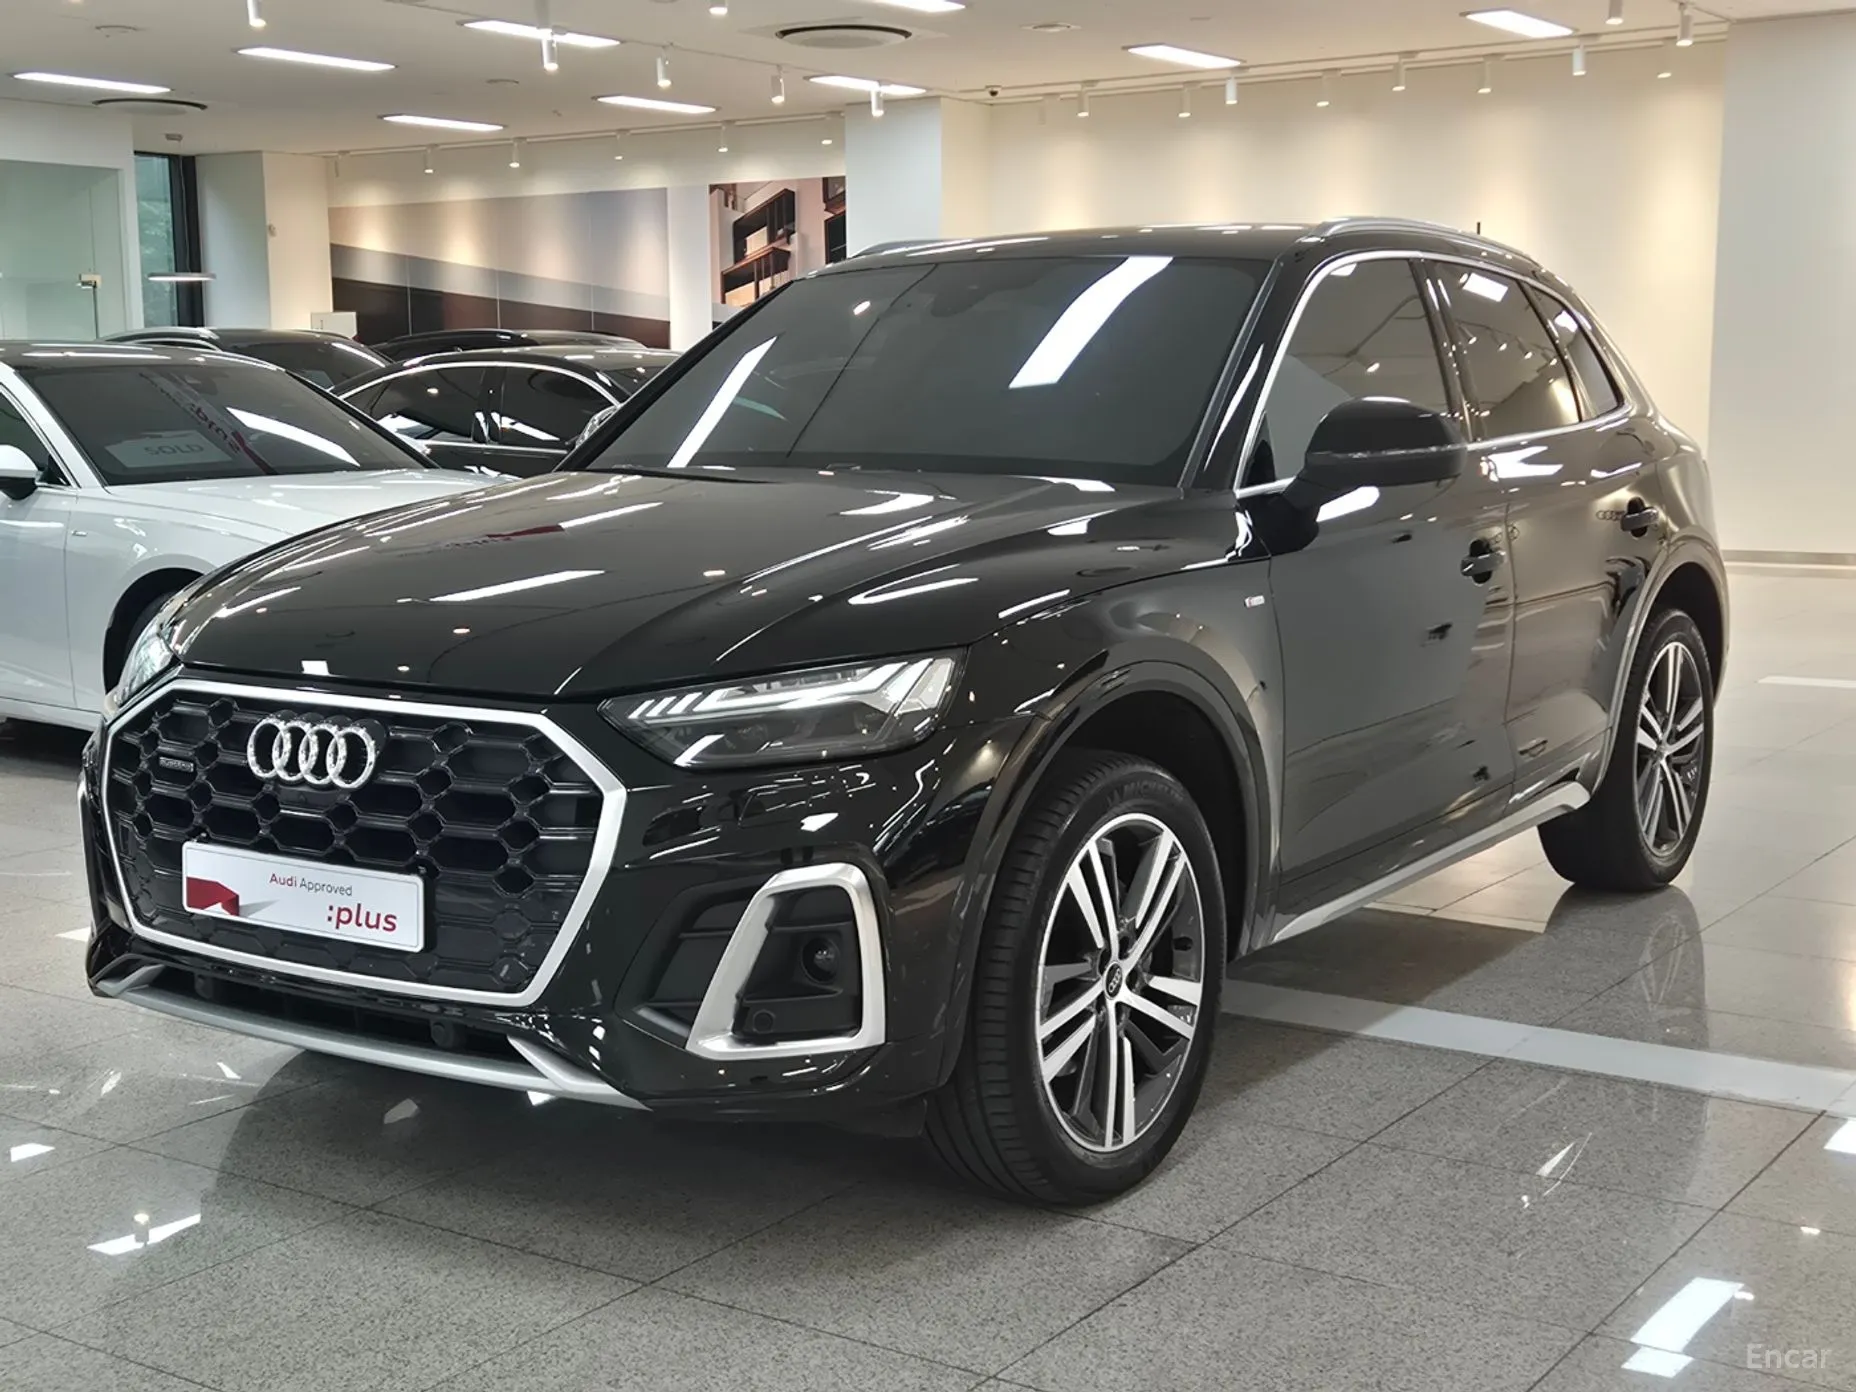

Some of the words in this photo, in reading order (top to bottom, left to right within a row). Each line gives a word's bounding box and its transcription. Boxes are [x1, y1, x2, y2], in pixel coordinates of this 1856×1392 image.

[144, 443, 205, 456] SOLD
[269, 873, 297, 887] Audi
[299, 877, 353, 897] Approved
